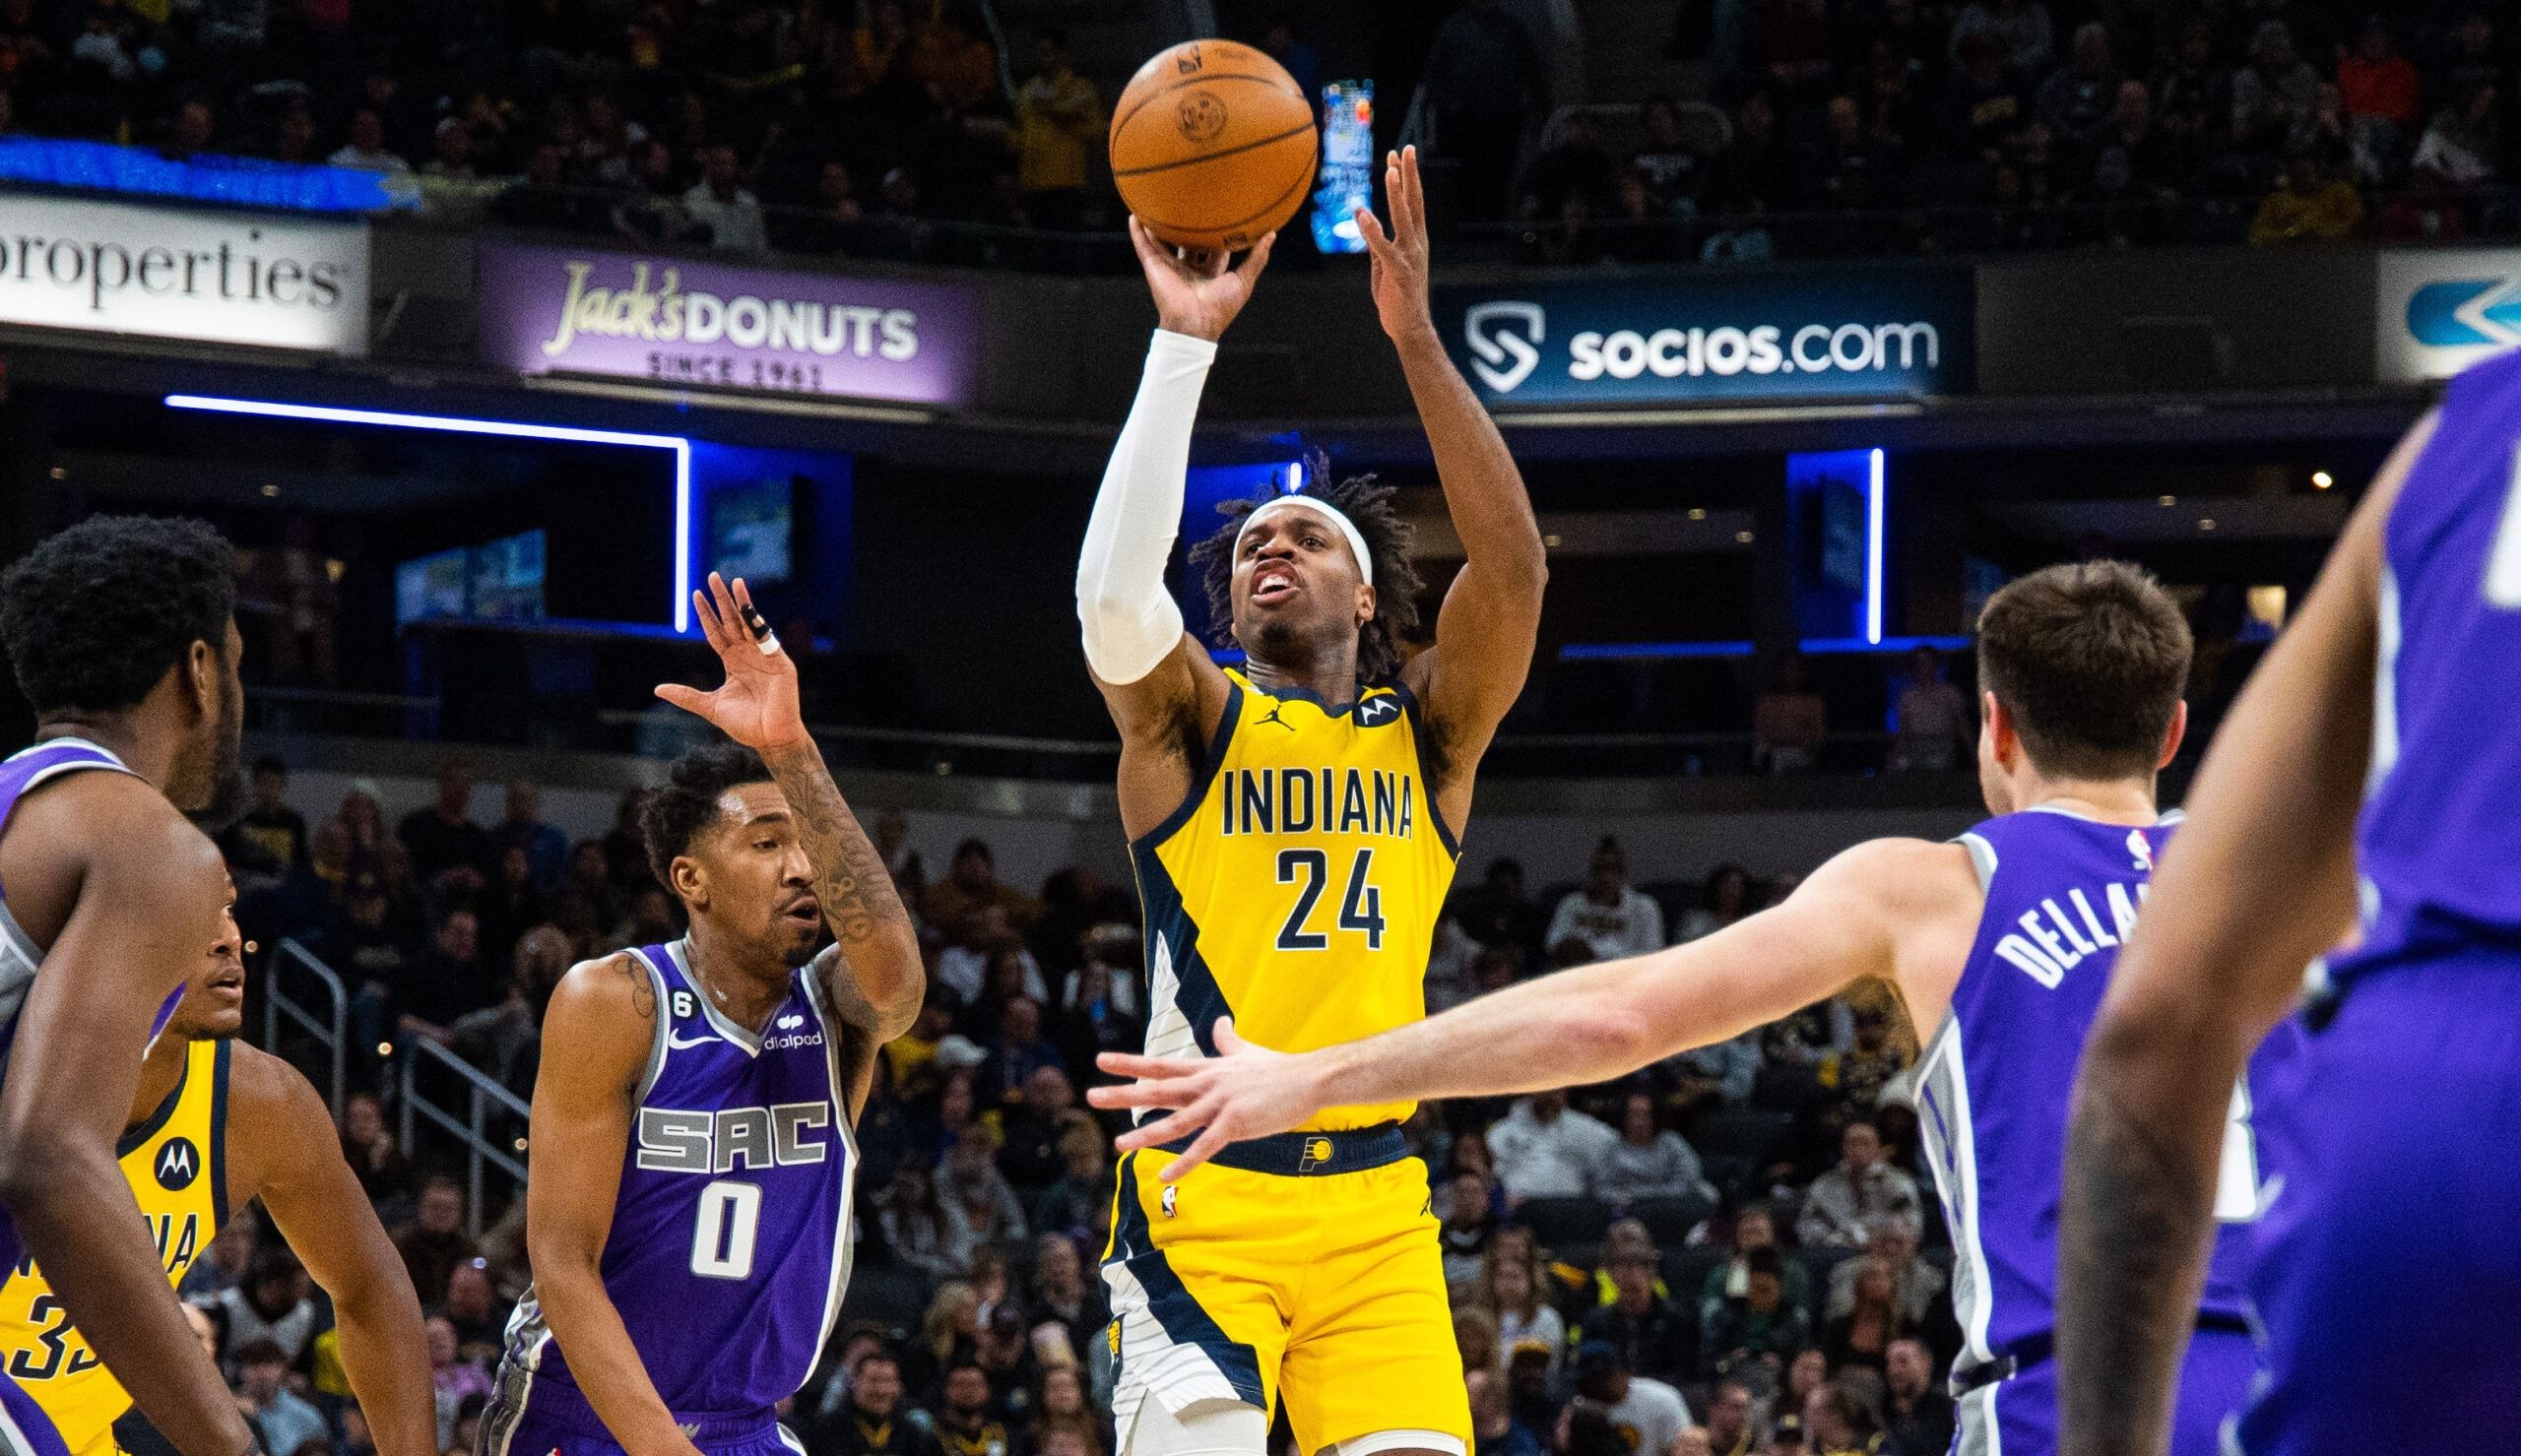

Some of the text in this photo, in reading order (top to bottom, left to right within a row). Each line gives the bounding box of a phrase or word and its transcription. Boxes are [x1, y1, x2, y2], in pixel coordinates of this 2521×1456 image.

[647, 350, 822, 391] SINCE 1961
[1221, 766, 1413, 842] INDIANA
[1275, 848, 1387, 952] 24
[1994, 883, 2150, 990] DELLA
[674, 990, 692, 1018] 6
[764, 1031, 823, 1050] dialpad
[637, 1101, 828, 1173] SAC
[689, 1180, 762, 1280] 0
